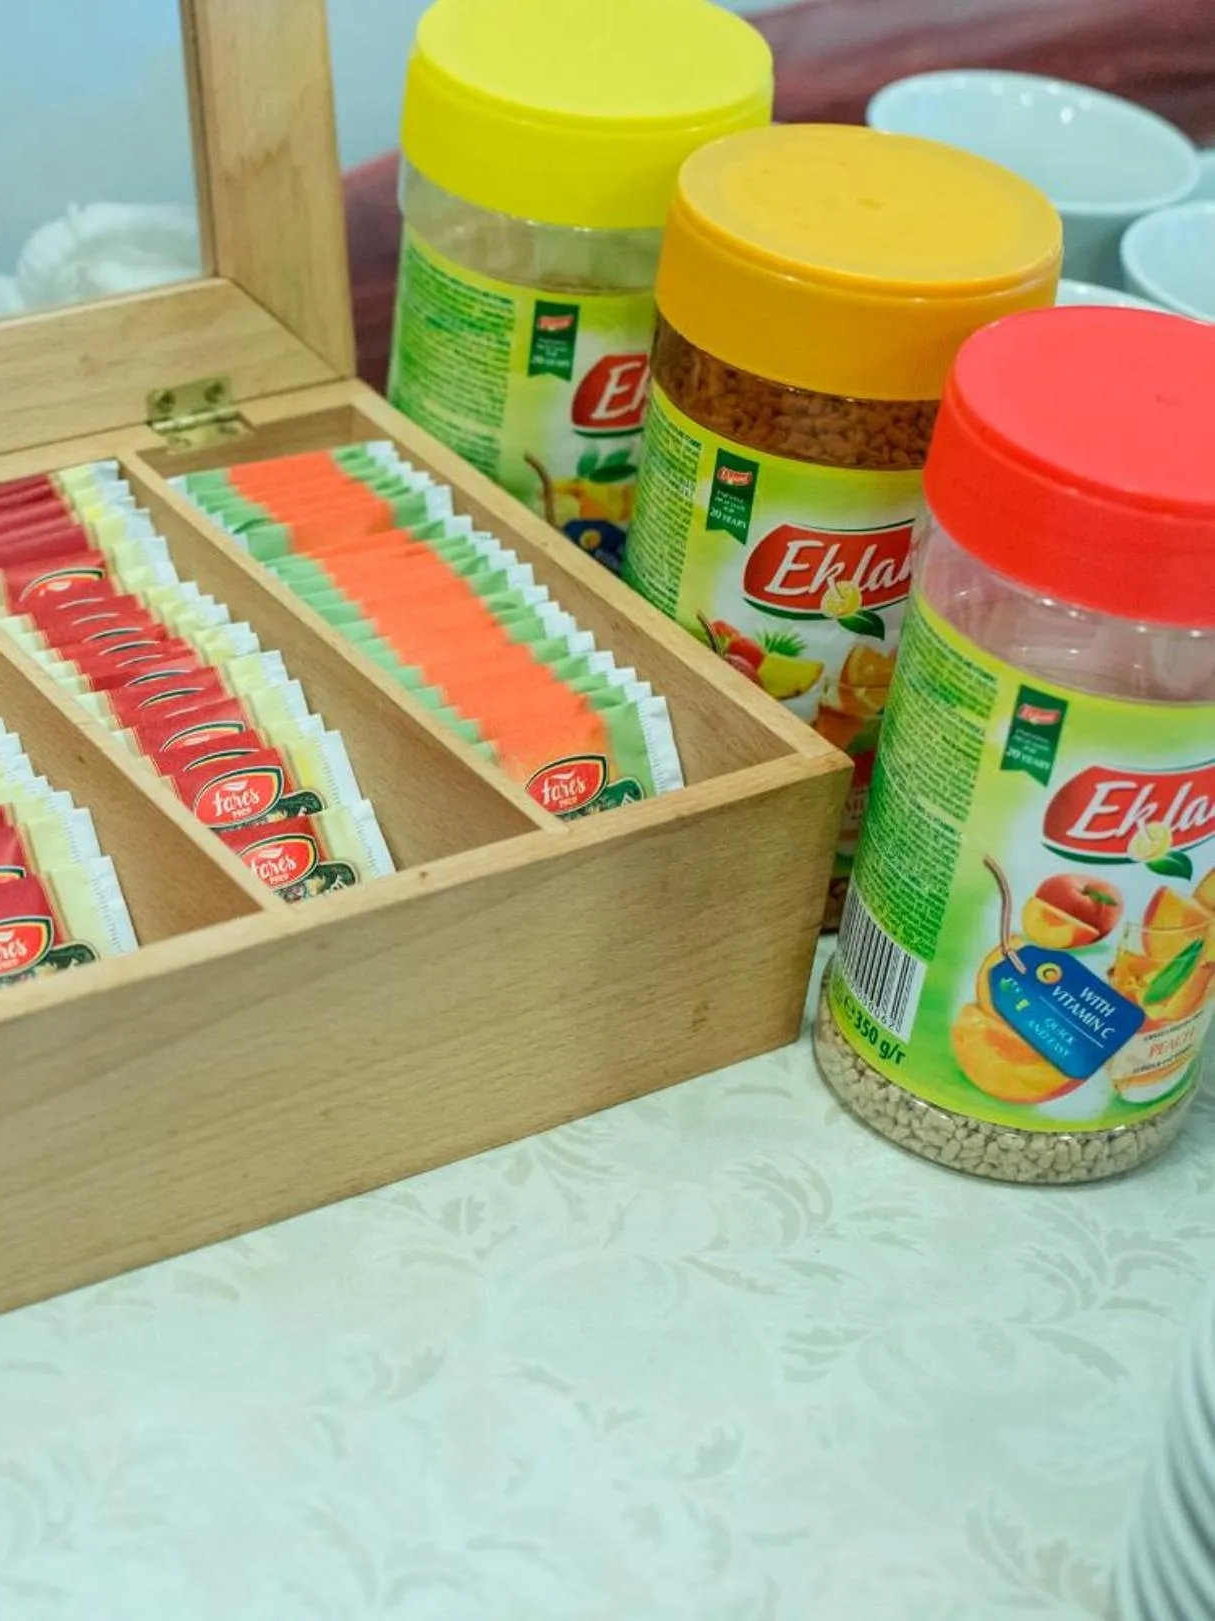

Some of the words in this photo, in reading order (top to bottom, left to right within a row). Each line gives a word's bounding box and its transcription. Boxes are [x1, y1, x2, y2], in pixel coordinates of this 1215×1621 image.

[1065, 779, 1215, 845] Ekla
[1051, 984, 1105, 1034] VITAMIN
[1100, 1026, 1117, 1041] C
[1080, 986, 1117, 1018] WITH
[853, 1011, 879, 1045] 350
